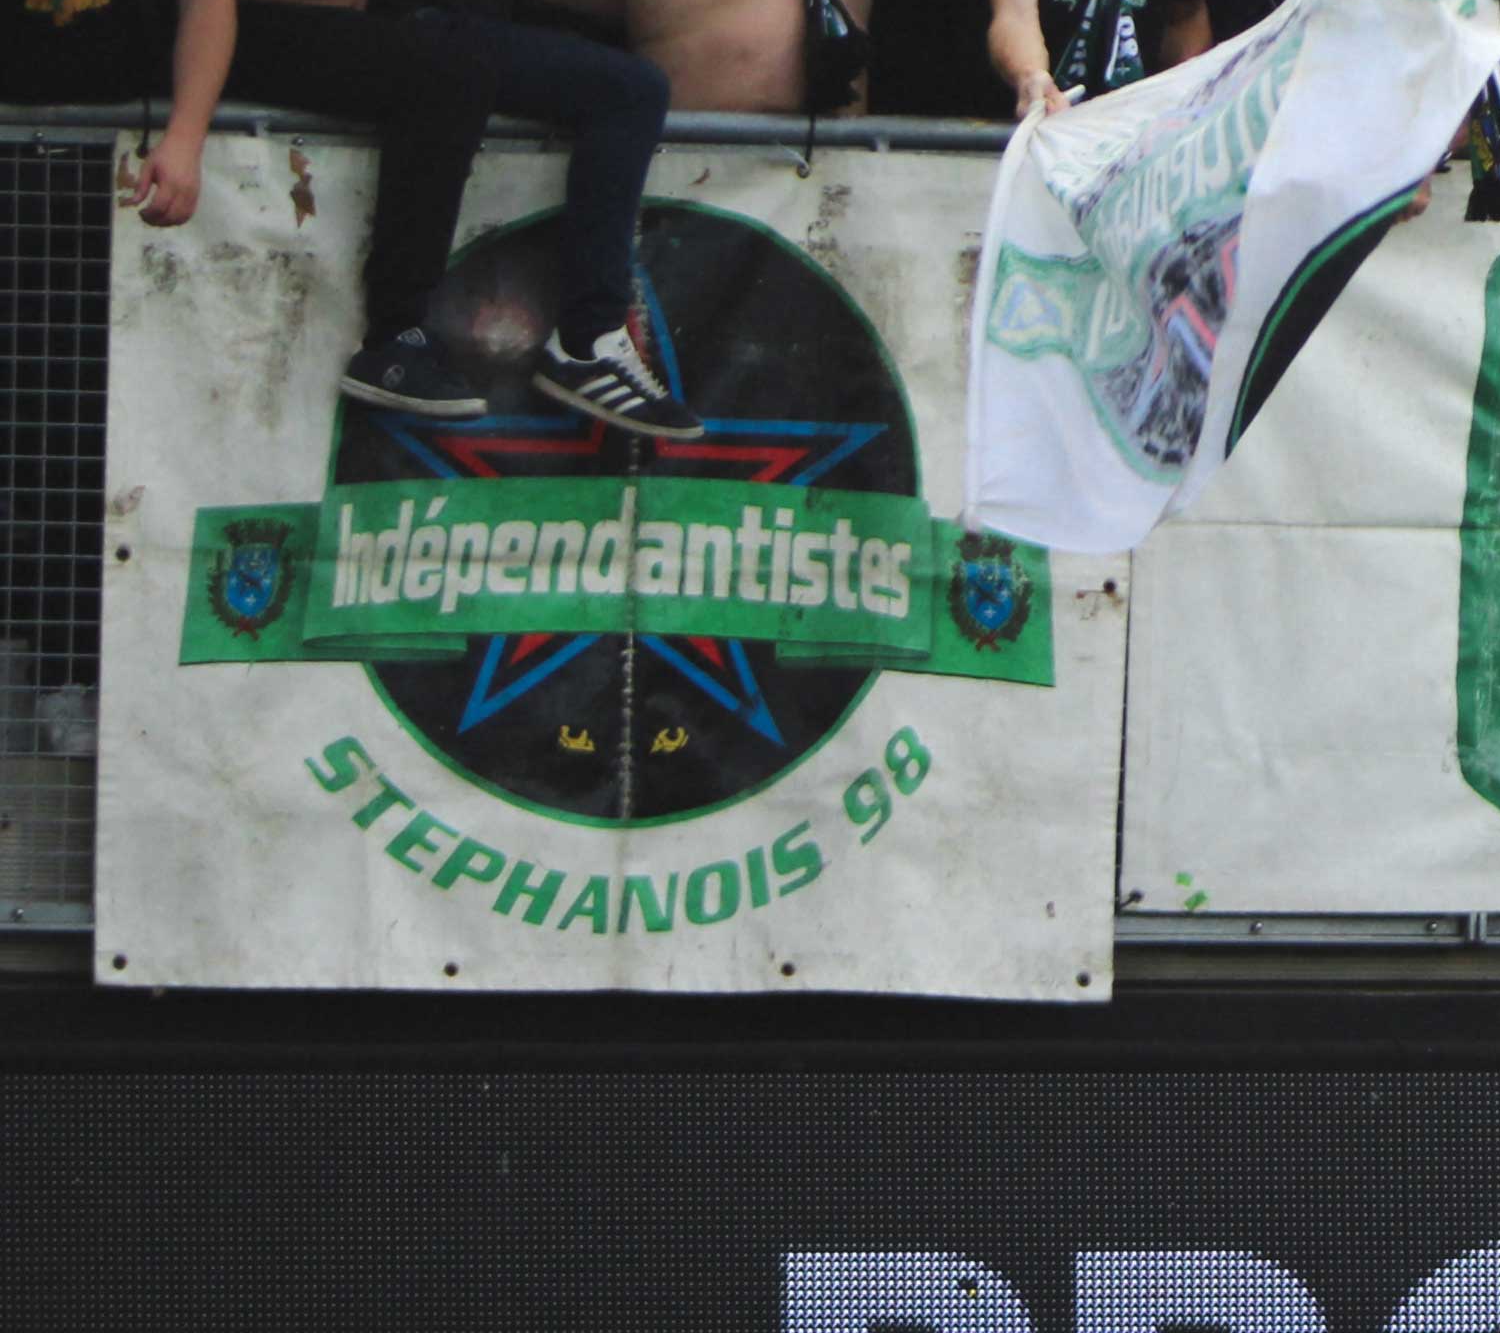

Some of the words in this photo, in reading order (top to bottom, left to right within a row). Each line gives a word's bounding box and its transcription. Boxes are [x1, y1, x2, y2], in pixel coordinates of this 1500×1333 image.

[333, 493, 912, 621] Indépendantistes
[304, 732, 825, 935] STEPHANOIS
[841, 724, 935, 844] 98
